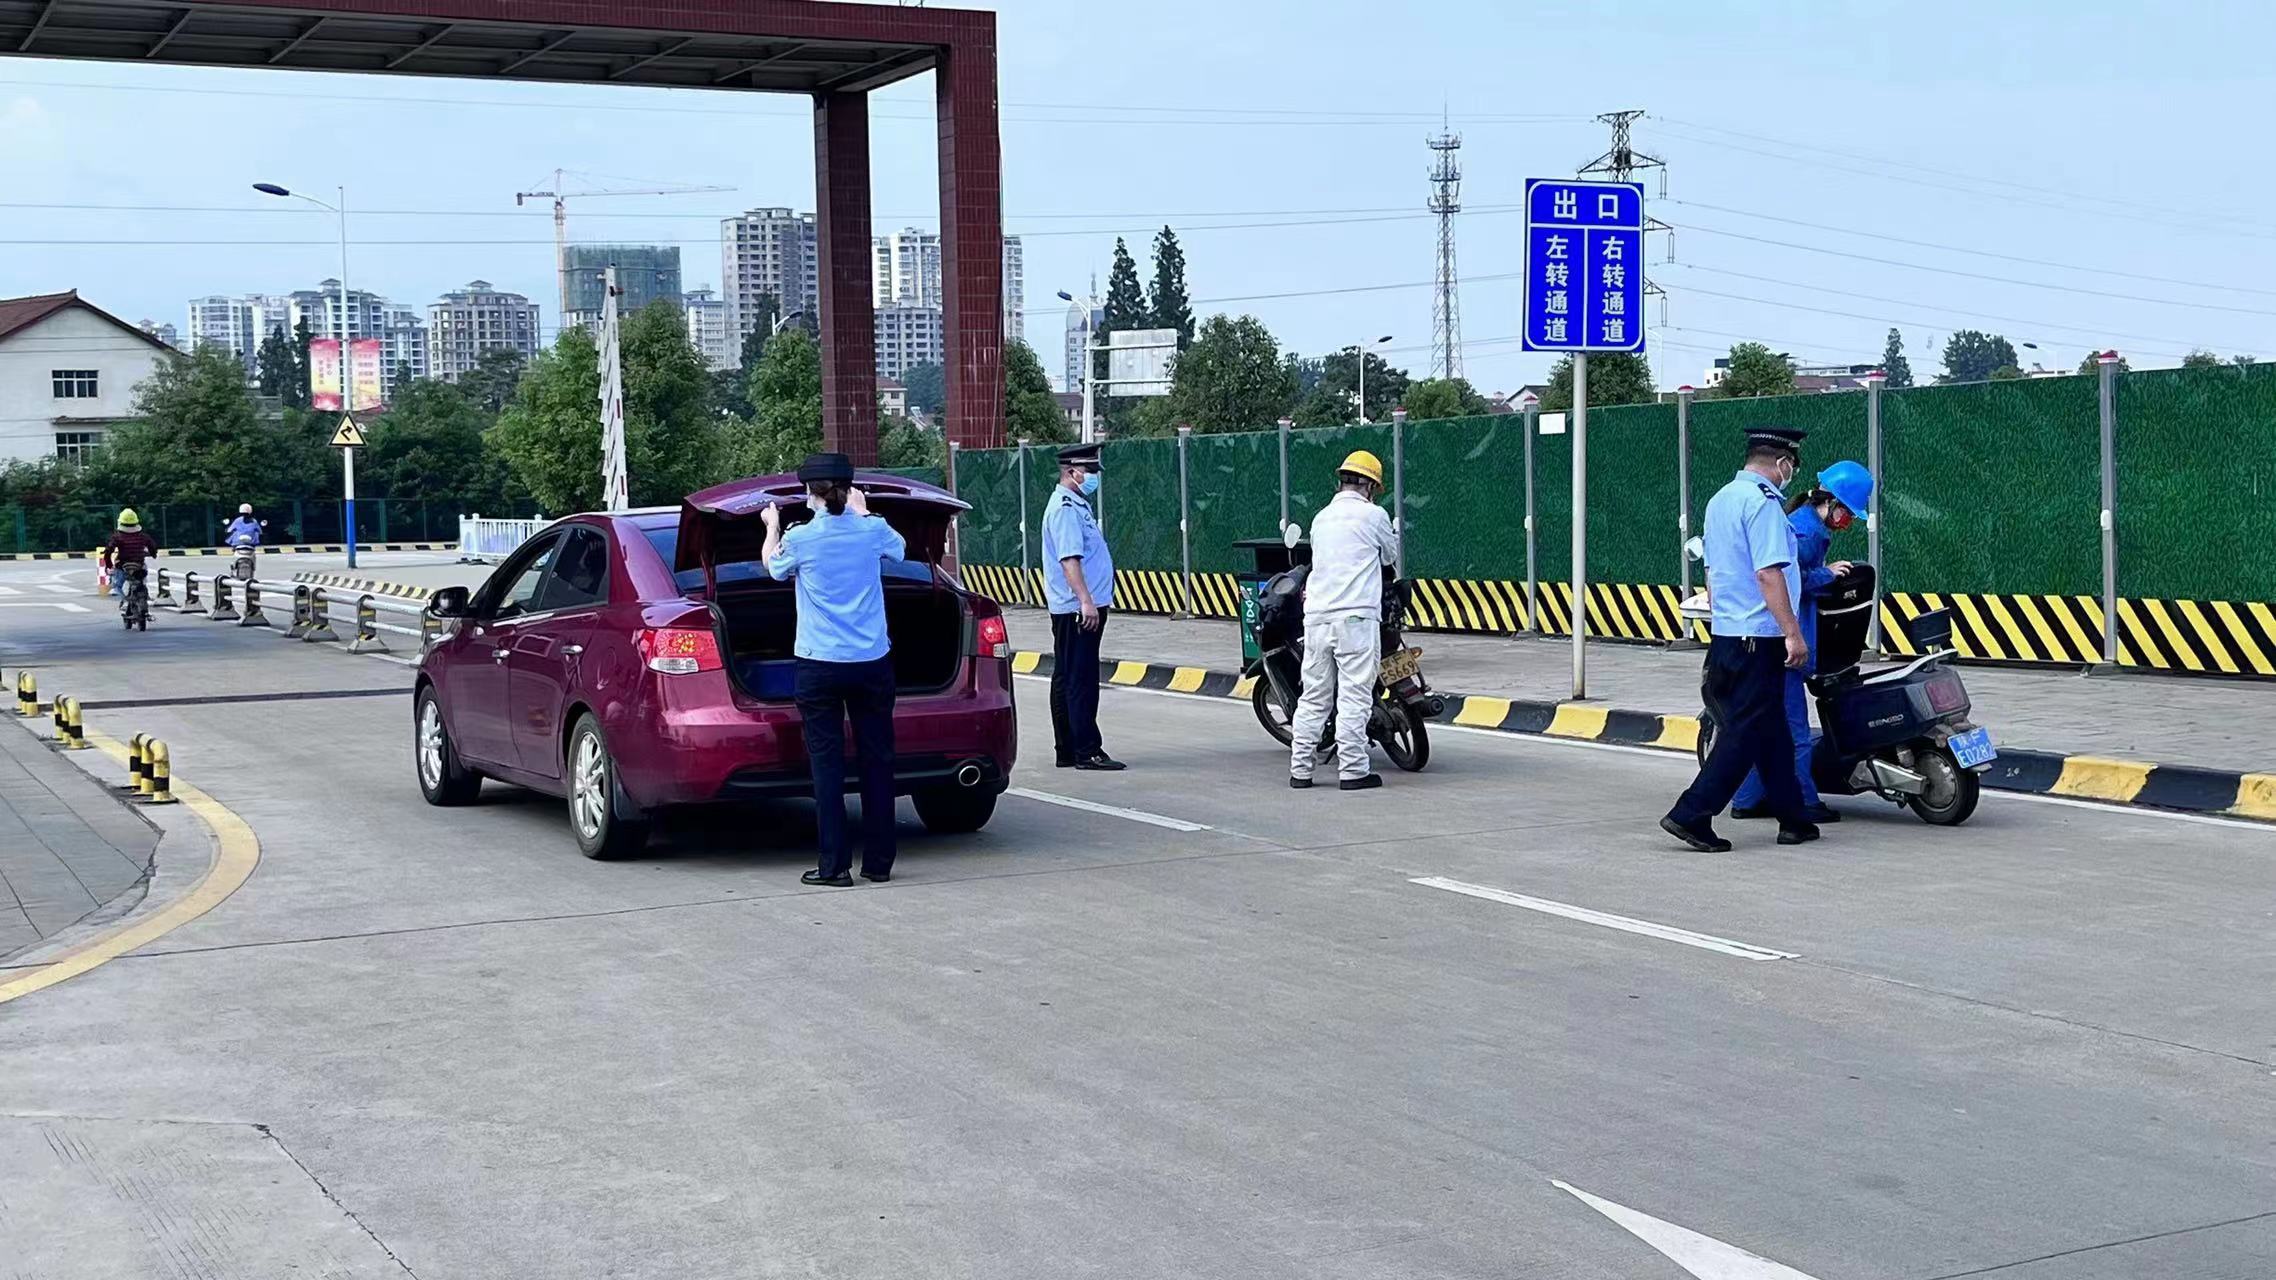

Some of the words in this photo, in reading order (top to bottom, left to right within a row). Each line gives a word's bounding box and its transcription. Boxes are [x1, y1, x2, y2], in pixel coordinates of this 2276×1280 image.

[1554, 189, 1618, 220] 出口
[1544, 234, 1569, 342] 左转通道
[1602, 236, 1625, 343] 右转通道
[1381, 661, 1415, 684] FS669
